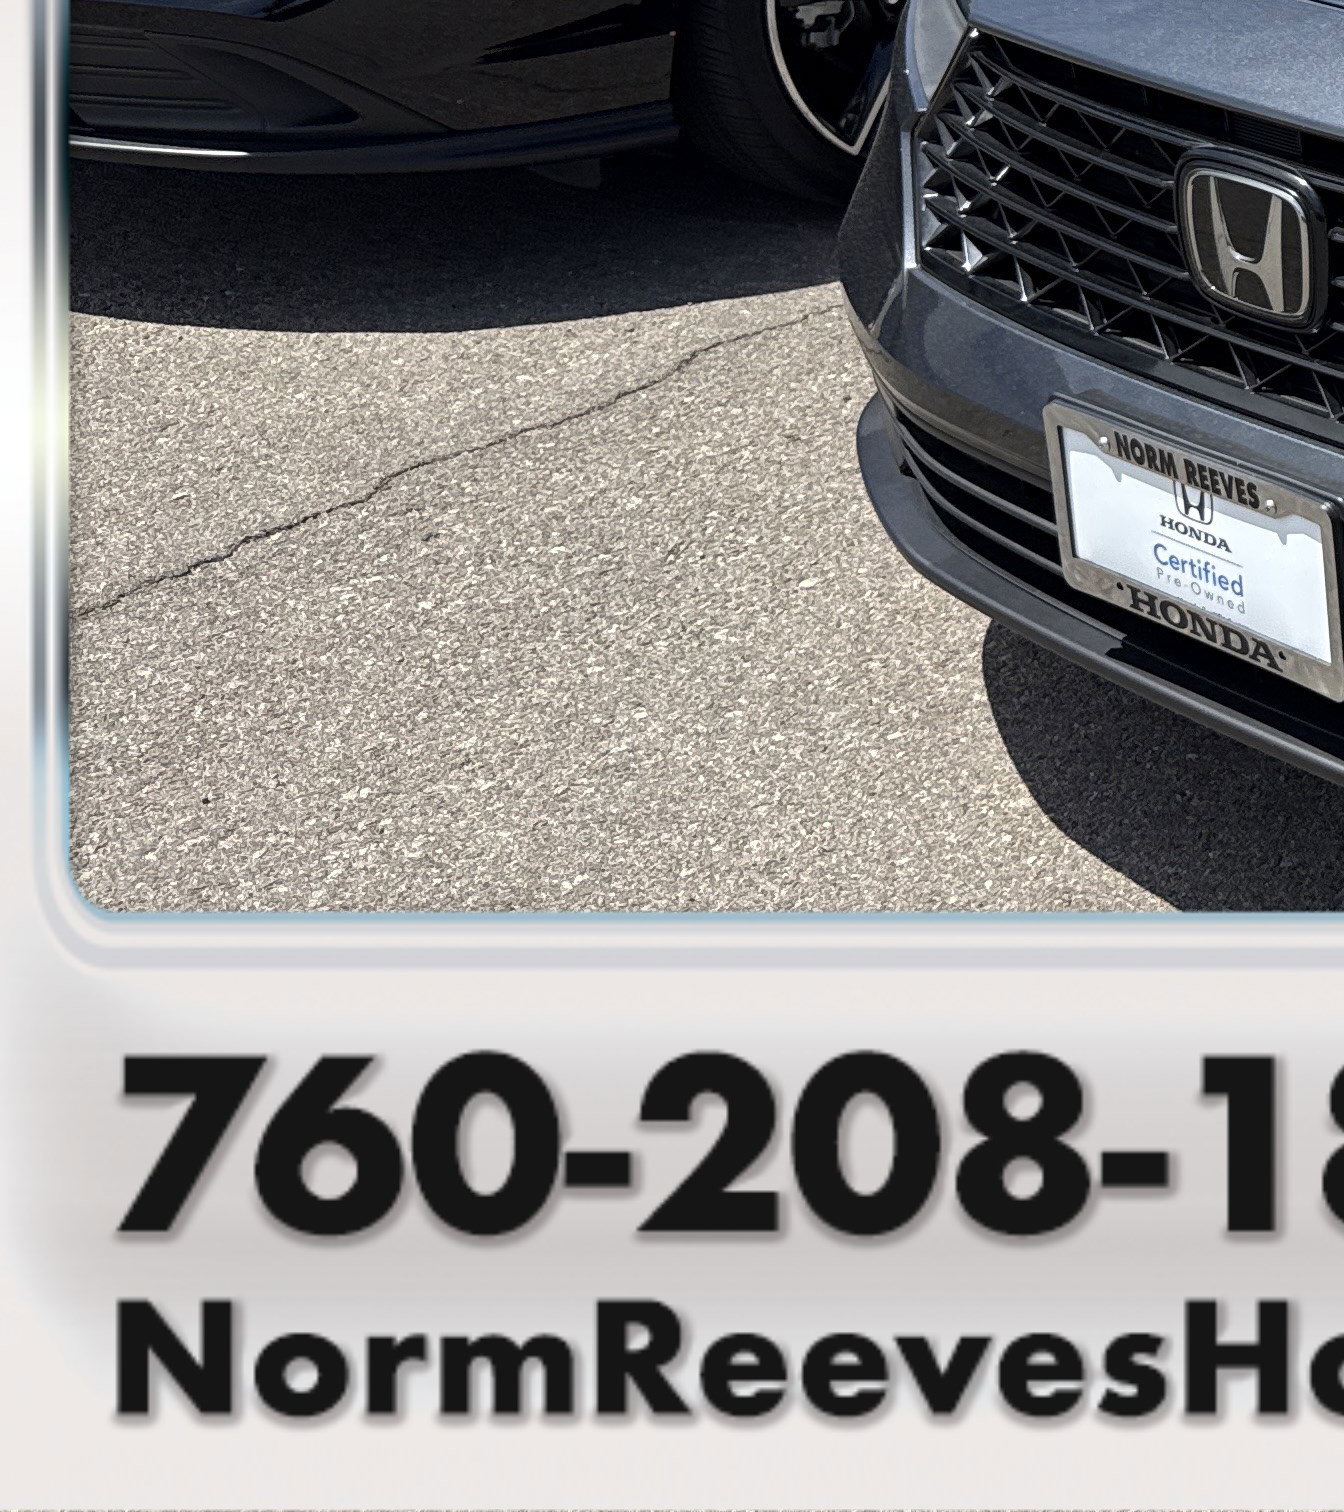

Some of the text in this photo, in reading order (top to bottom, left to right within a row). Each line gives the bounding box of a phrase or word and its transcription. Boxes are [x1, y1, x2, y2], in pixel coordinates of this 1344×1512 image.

[1113, 431, 1261, 510] NORM REEVES
[1159, 514, 1232, 553] HONDA
[1153, 542, 1244, 597] Certified
[1156, 566, 1246, 615] Pre-Owned
[1126, 583, 1285, 673] HONDA
